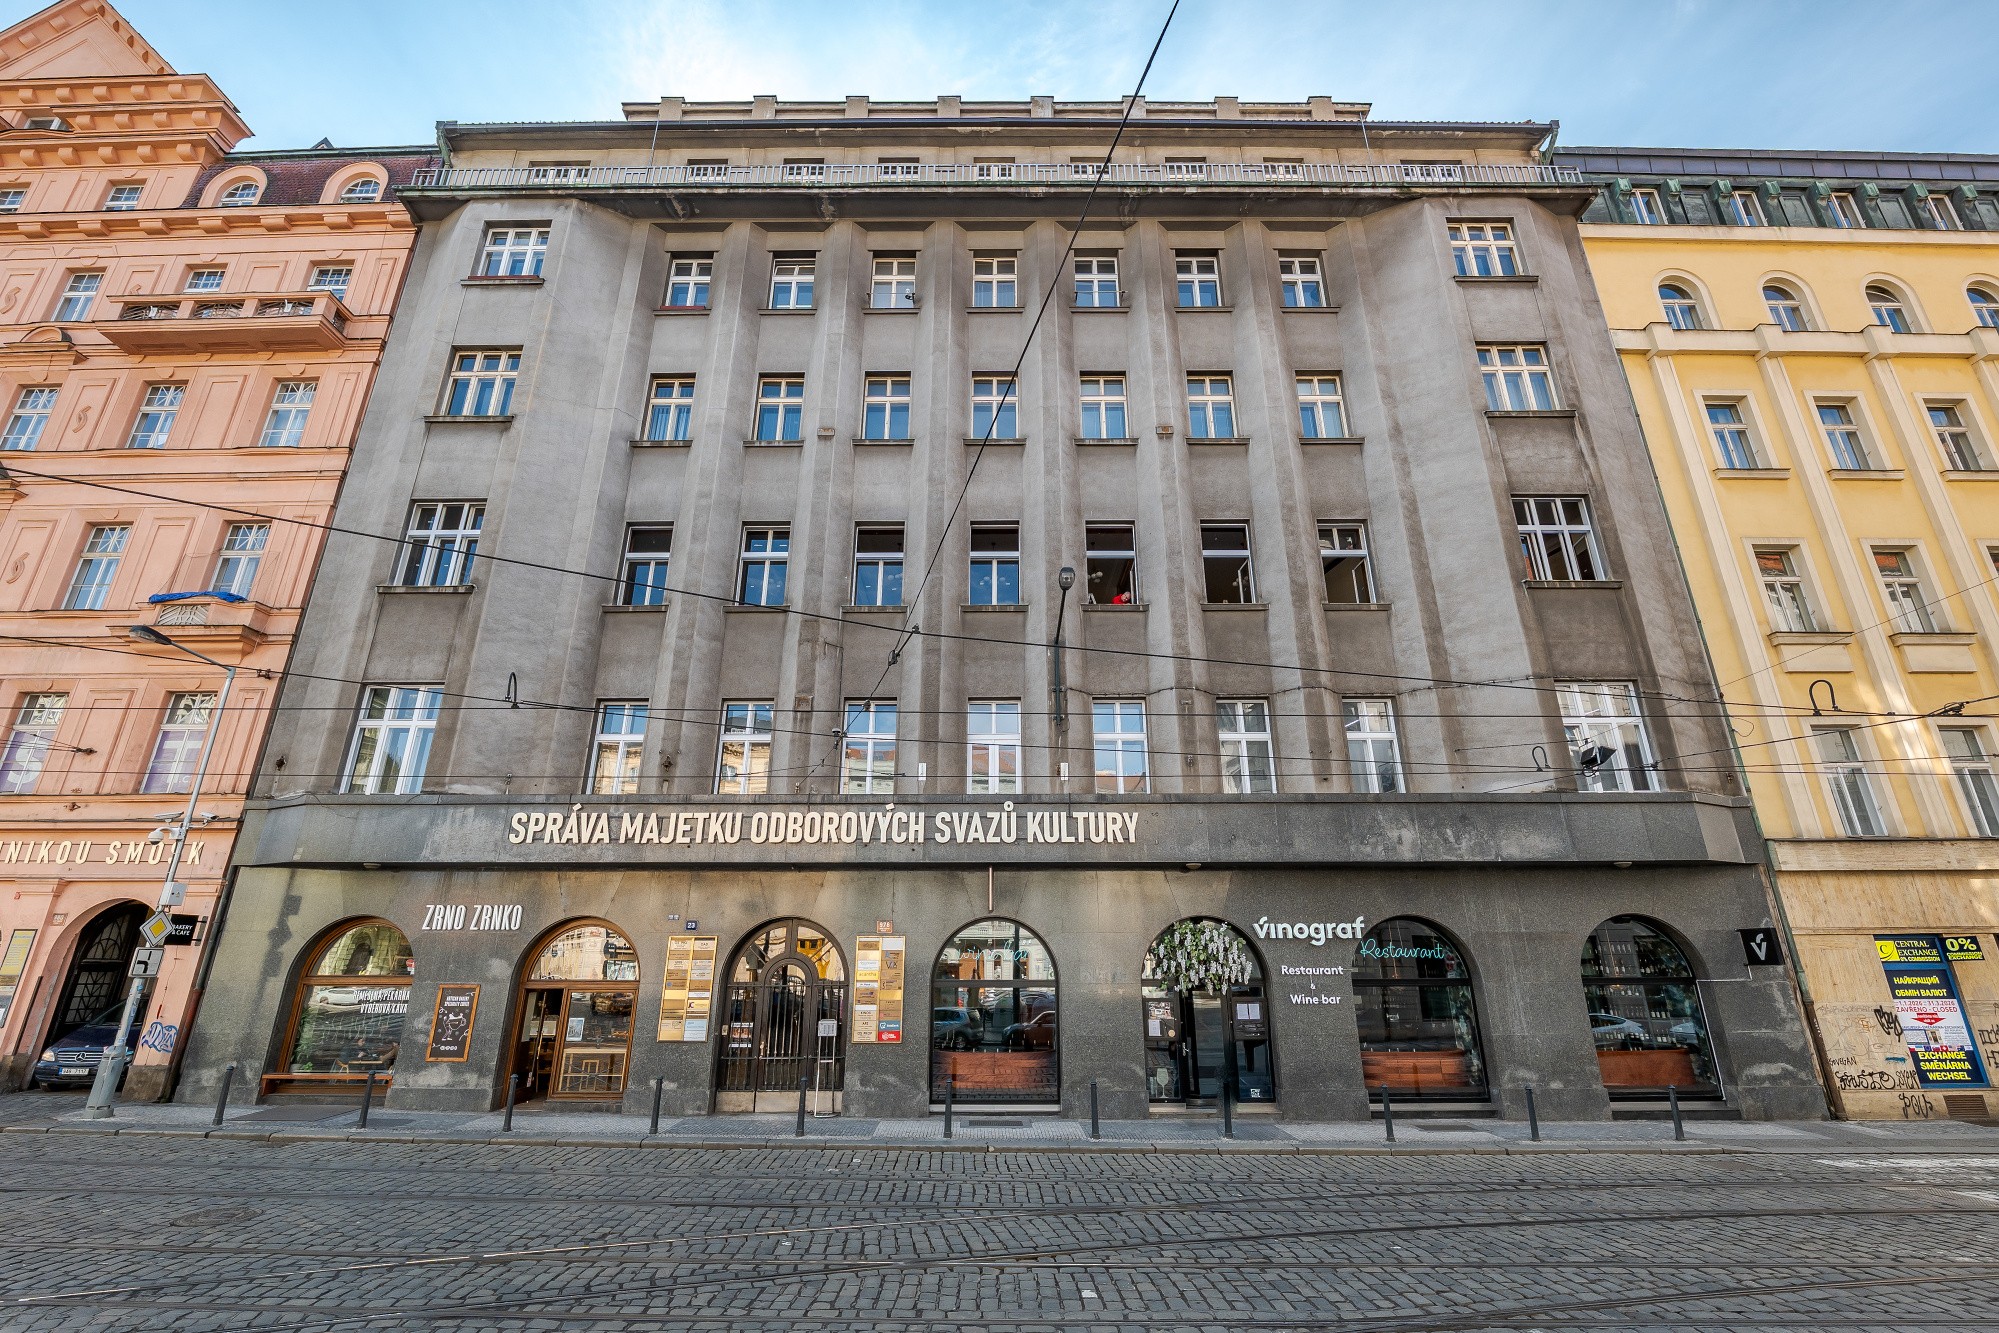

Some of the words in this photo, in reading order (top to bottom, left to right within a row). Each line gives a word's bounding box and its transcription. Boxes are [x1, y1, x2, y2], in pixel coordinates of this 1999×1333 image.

[508, 802, 610, 844] SPRÁVA
[619, 812, 743, 844] MAJETKU
[750, 802, 925, 844] ODBOROVÝCH
[934, 801, 1017, 844] SVAZŮ
[1027, 811, 1139, 844] KULTURY
[0, 840, 92, 865] NIKOU
[422, 904, 467, 931] ZRNO
[469, 904, 523, 931] ZRNKO
[1360, 938, 1445, 960] Restaurant
[1894, 940, 1930, 948] CENTRAL
[1945, 937, 1977, 952] 0%
[1897, 948, 1939, 956] EXCHANGE
[1281, 965, 1344, 975] Restaurant
[1290, 994, 1319, 1005] Wine
[1321, 994, 1341, 1005] bar
[1918, 1051, 1967, 1060] EXCHANGE
[1919, 1059, 1972, 1070] SMĚNÁRNA
[1927, 1071, 1972, 1081] WECHSEL
